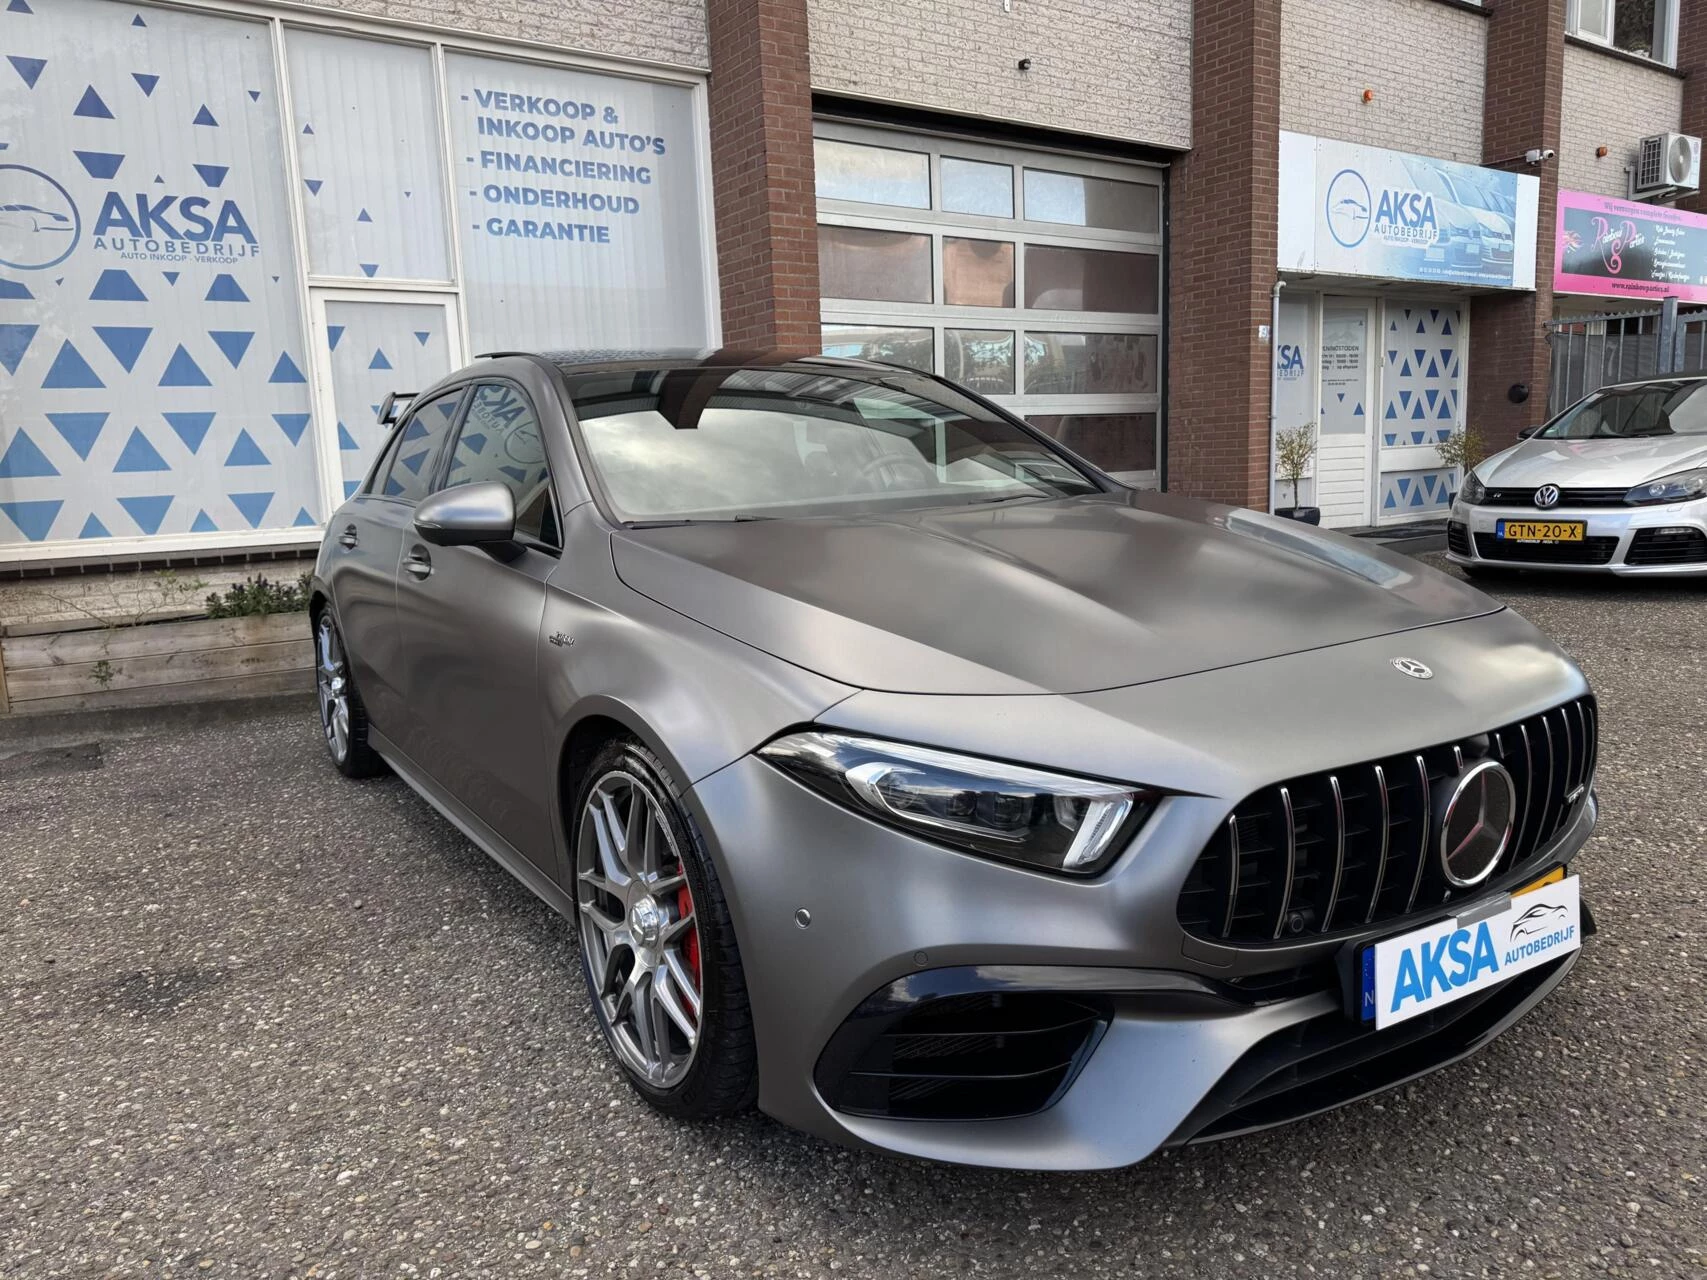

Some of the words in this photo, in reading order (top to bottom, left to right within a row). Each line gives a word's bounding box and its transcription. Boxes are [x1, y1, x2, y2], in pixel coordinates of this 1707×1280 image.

[474, 88, 595, 120] VERKOOP
[603, 106, 619, 124] &
[477, 117, 575, 144] INKOOP
[582, 129, 666, 155] AUTO'S
[480, 150, 651, 184] FINANCIERING
[483, 184, 640, 214] ONDERHOUD
[1375, 189, 1437, 230] AKSA
[93, 191, 258, 244] AKSA
[486, 217, 610, 244] GARANTIE
[1374, 223, 1438, 240] AUTOBEDRIJF
[94, 237, 259, 257] AUTOBEDRIJF
[120, 251, 147, 260] AUTO
[150, 253, 187, 262] INKOOP
[195, 255, 238, 265] VERKOOP
[1277, 344, 1304, 369] SA
[1508, 524, 1577, 538] GTN-20-X
[1390, 921, 1499, 1013] AKSA
[1504, 925, 1575, 966] AUTOBEDRIJF
[1365, 991, 1375, 1008] N
